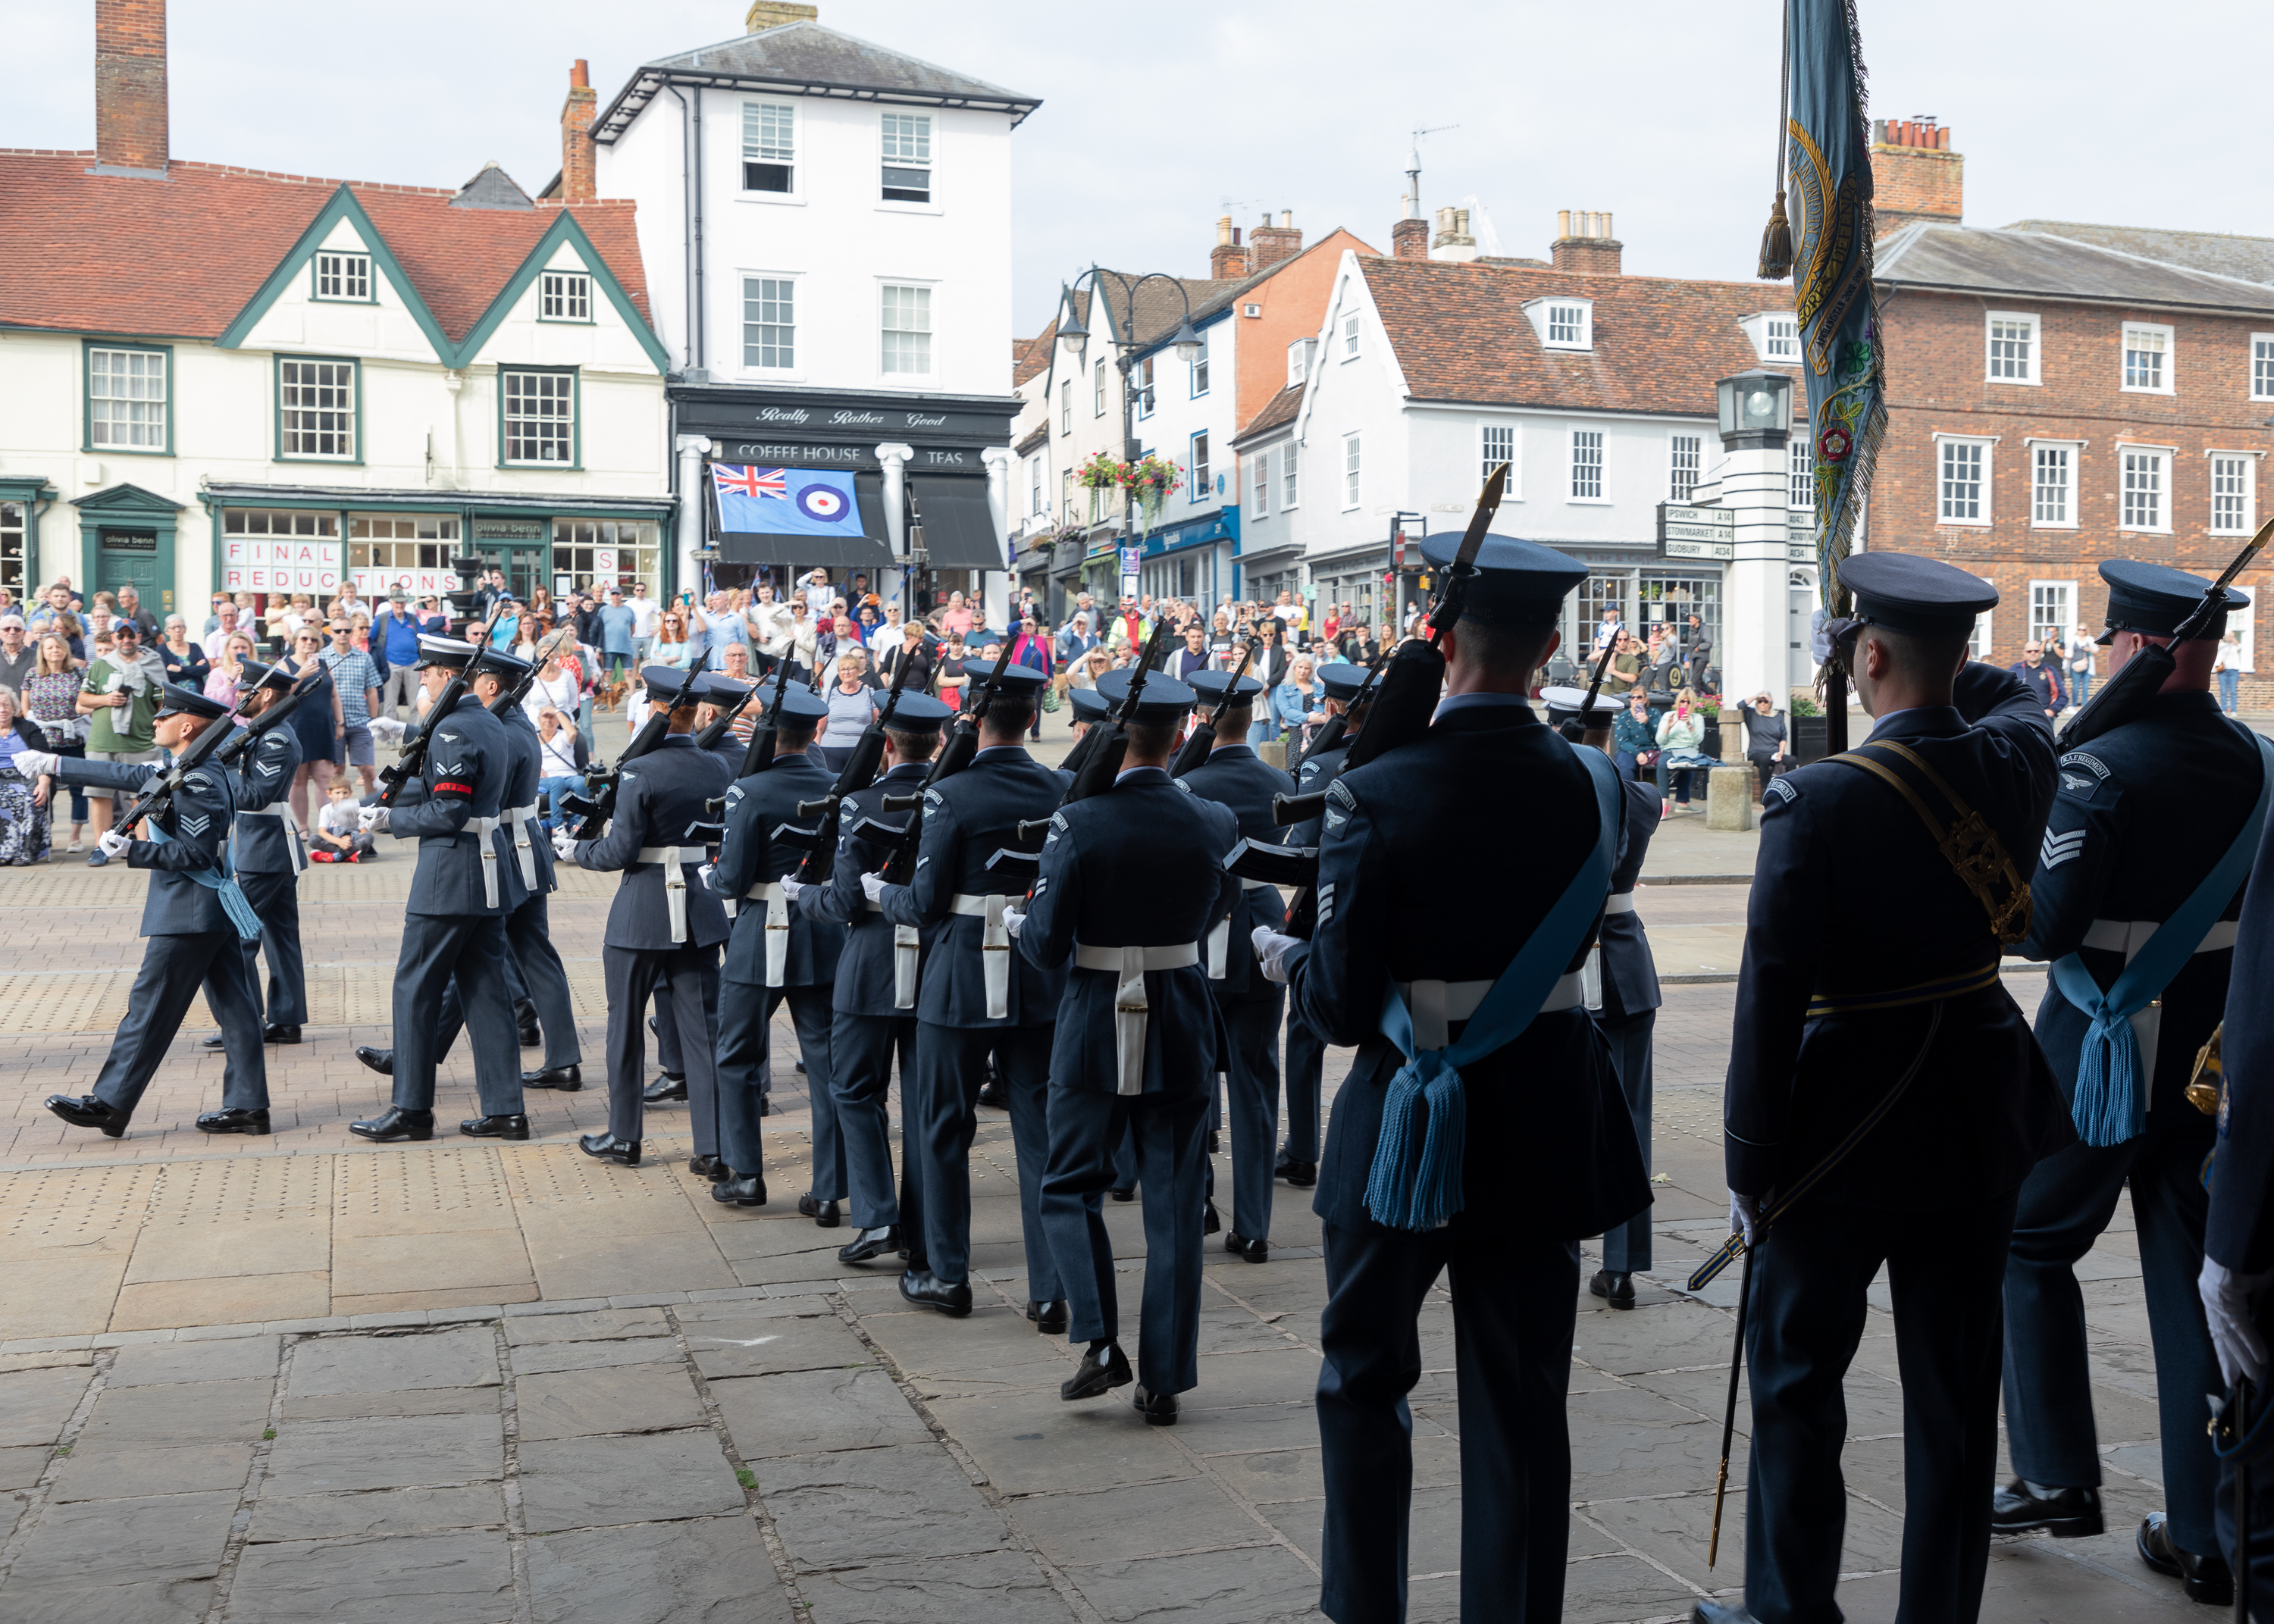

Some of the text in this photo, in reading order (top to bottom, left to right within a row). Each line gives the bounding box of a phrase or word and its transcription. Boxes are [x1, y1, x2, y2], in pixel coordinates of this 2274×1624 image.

[1797, 159, 1822, 236] REGIMENT
[1815, 266, 1867, 347] AFGHANISTAN 2001-2014
[756, 406, 948, 428] Really Rather Good
[738, 443, 861, 462] COFFEE HOUSE
[926, 451, 963, 465] TEAS
[1668, 509, 1698, 519] IPSWICH
[476, 522, 541, 534] olivia benn
[1666, 526, 1713, 538] STOWMARKET
[105, 534, 155, 545] olivia benn
[230, 543, 334, 562] FINAL
[1667, 543, 1701, 555] SUDBURY
[1586, 552, 1612, 562] Wine
[1616, 554, 1624, 562] &
[1627, 554, 1662, 565] Coffee
[228, 571, 456, 590] REDUCTIONS
[2078, 754, 2107, 776] REGIMENT
[1771, 781, 1793, 798] REGIMENT
